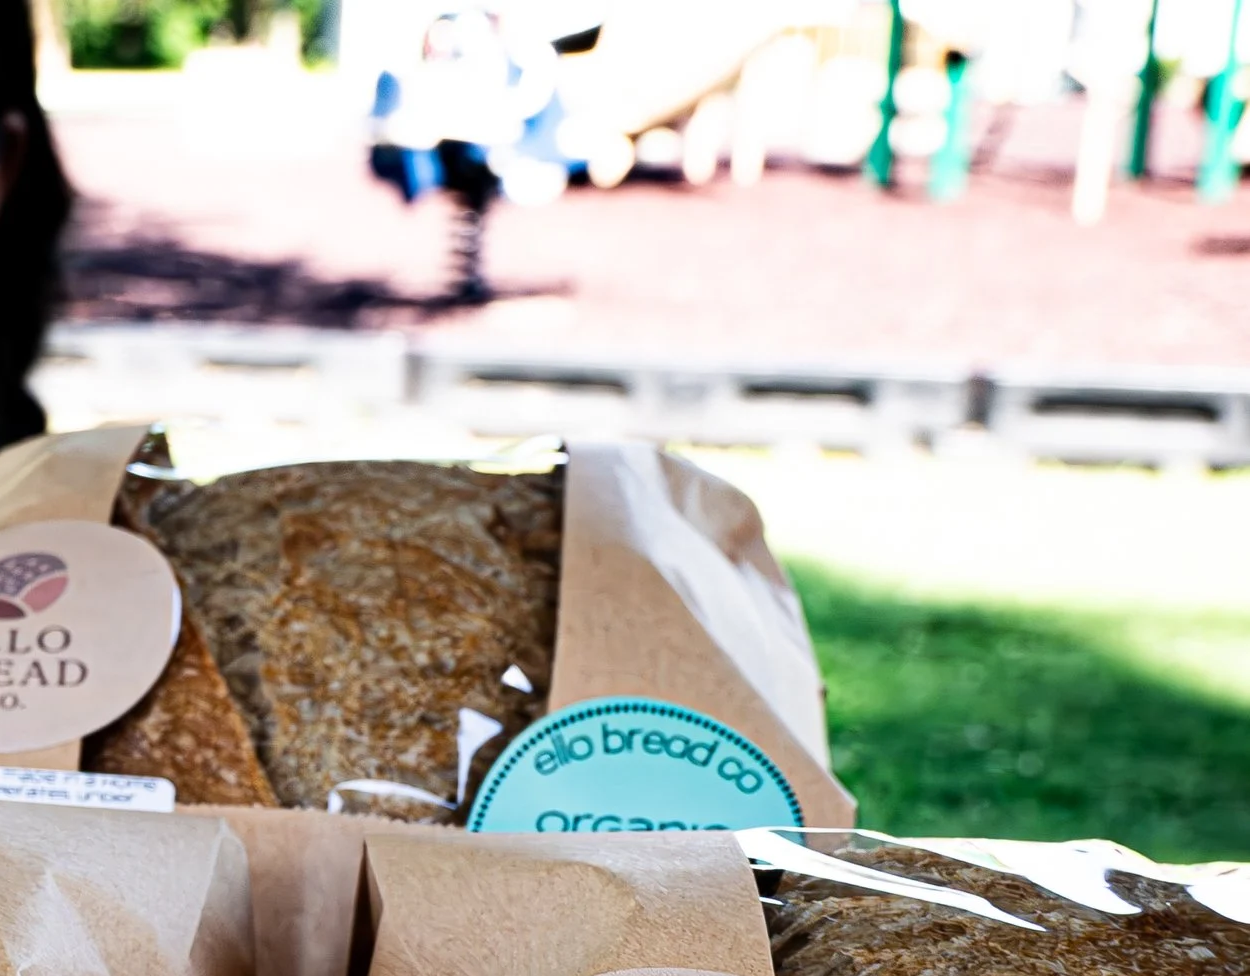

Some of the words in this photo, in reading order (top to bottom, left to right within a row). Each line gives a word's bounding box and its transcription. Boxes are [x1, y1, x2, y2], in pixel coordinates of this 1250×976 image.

[533, 728, 594, 776] ello
[602, 723, 719, 767] bread
[717, 756, 764, 794] co
